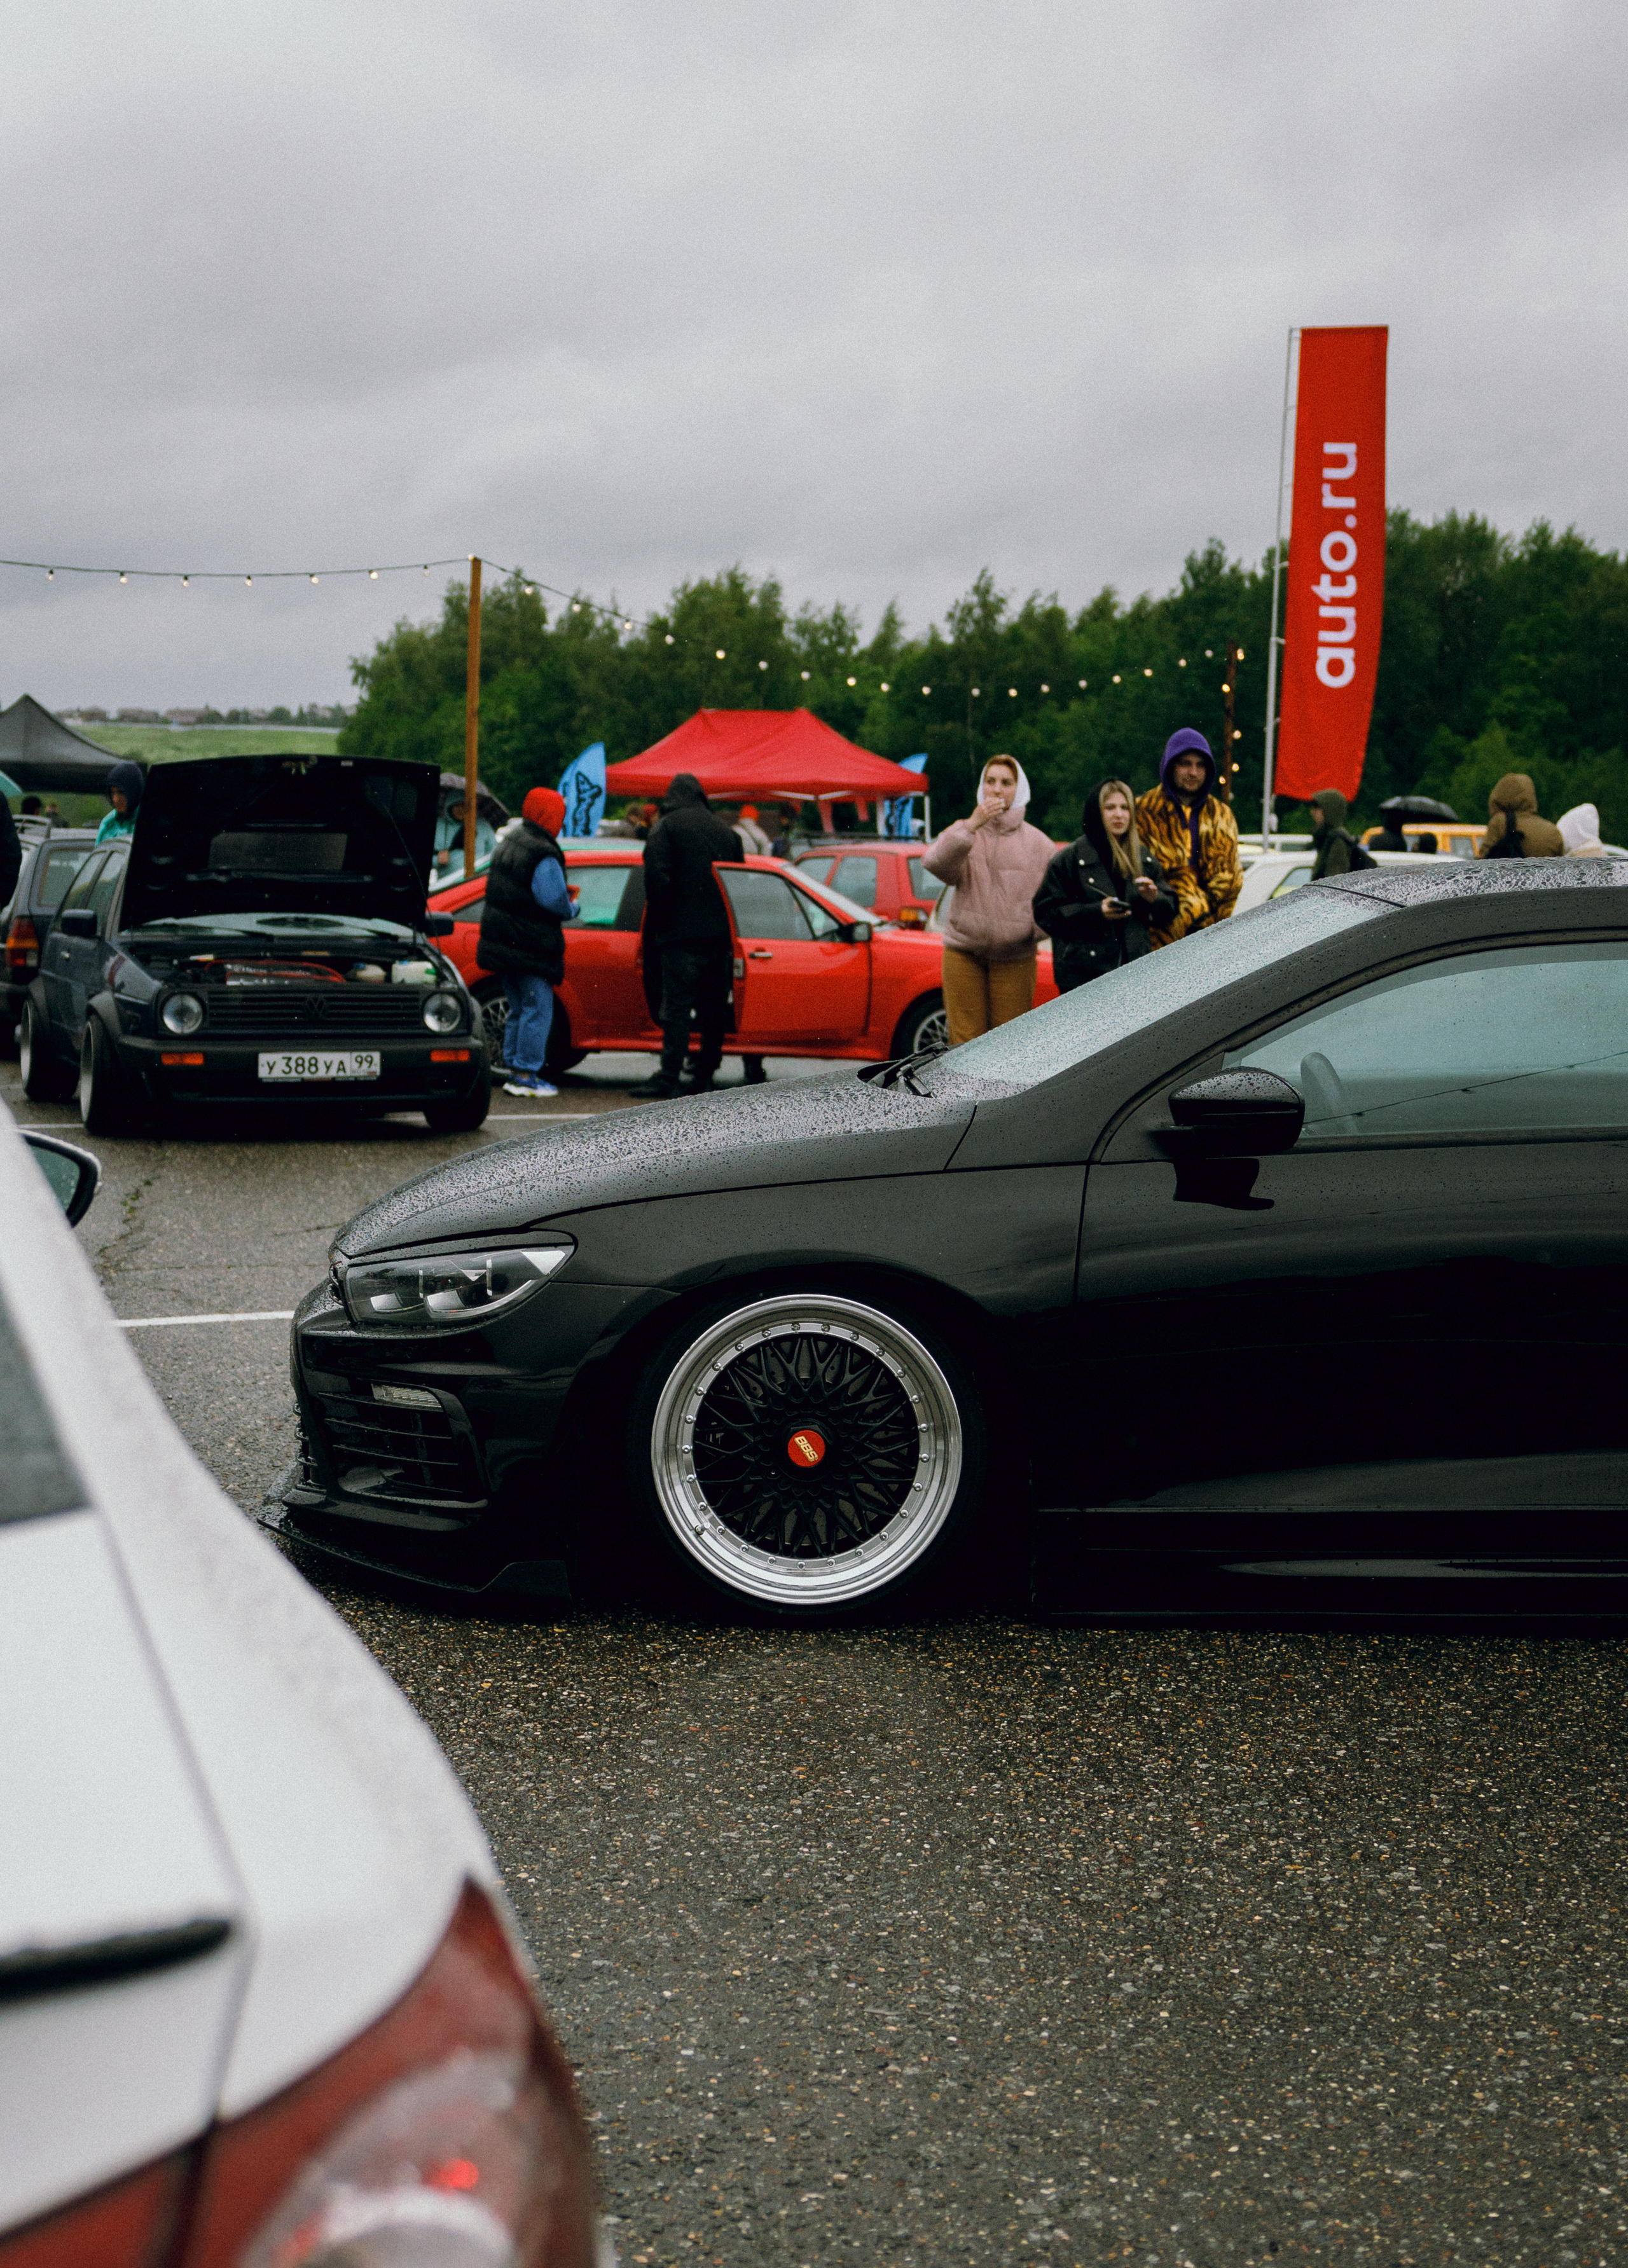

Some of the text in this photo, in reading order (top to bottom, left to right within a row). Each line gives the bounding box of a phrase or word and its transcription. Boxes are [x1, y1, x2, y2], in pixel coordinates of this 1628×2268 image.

[1311, 442, 1357, 688] auto.ru
[355, 1055, 373, 1068] 99
[794, 1436, 818, 1462] BBS
